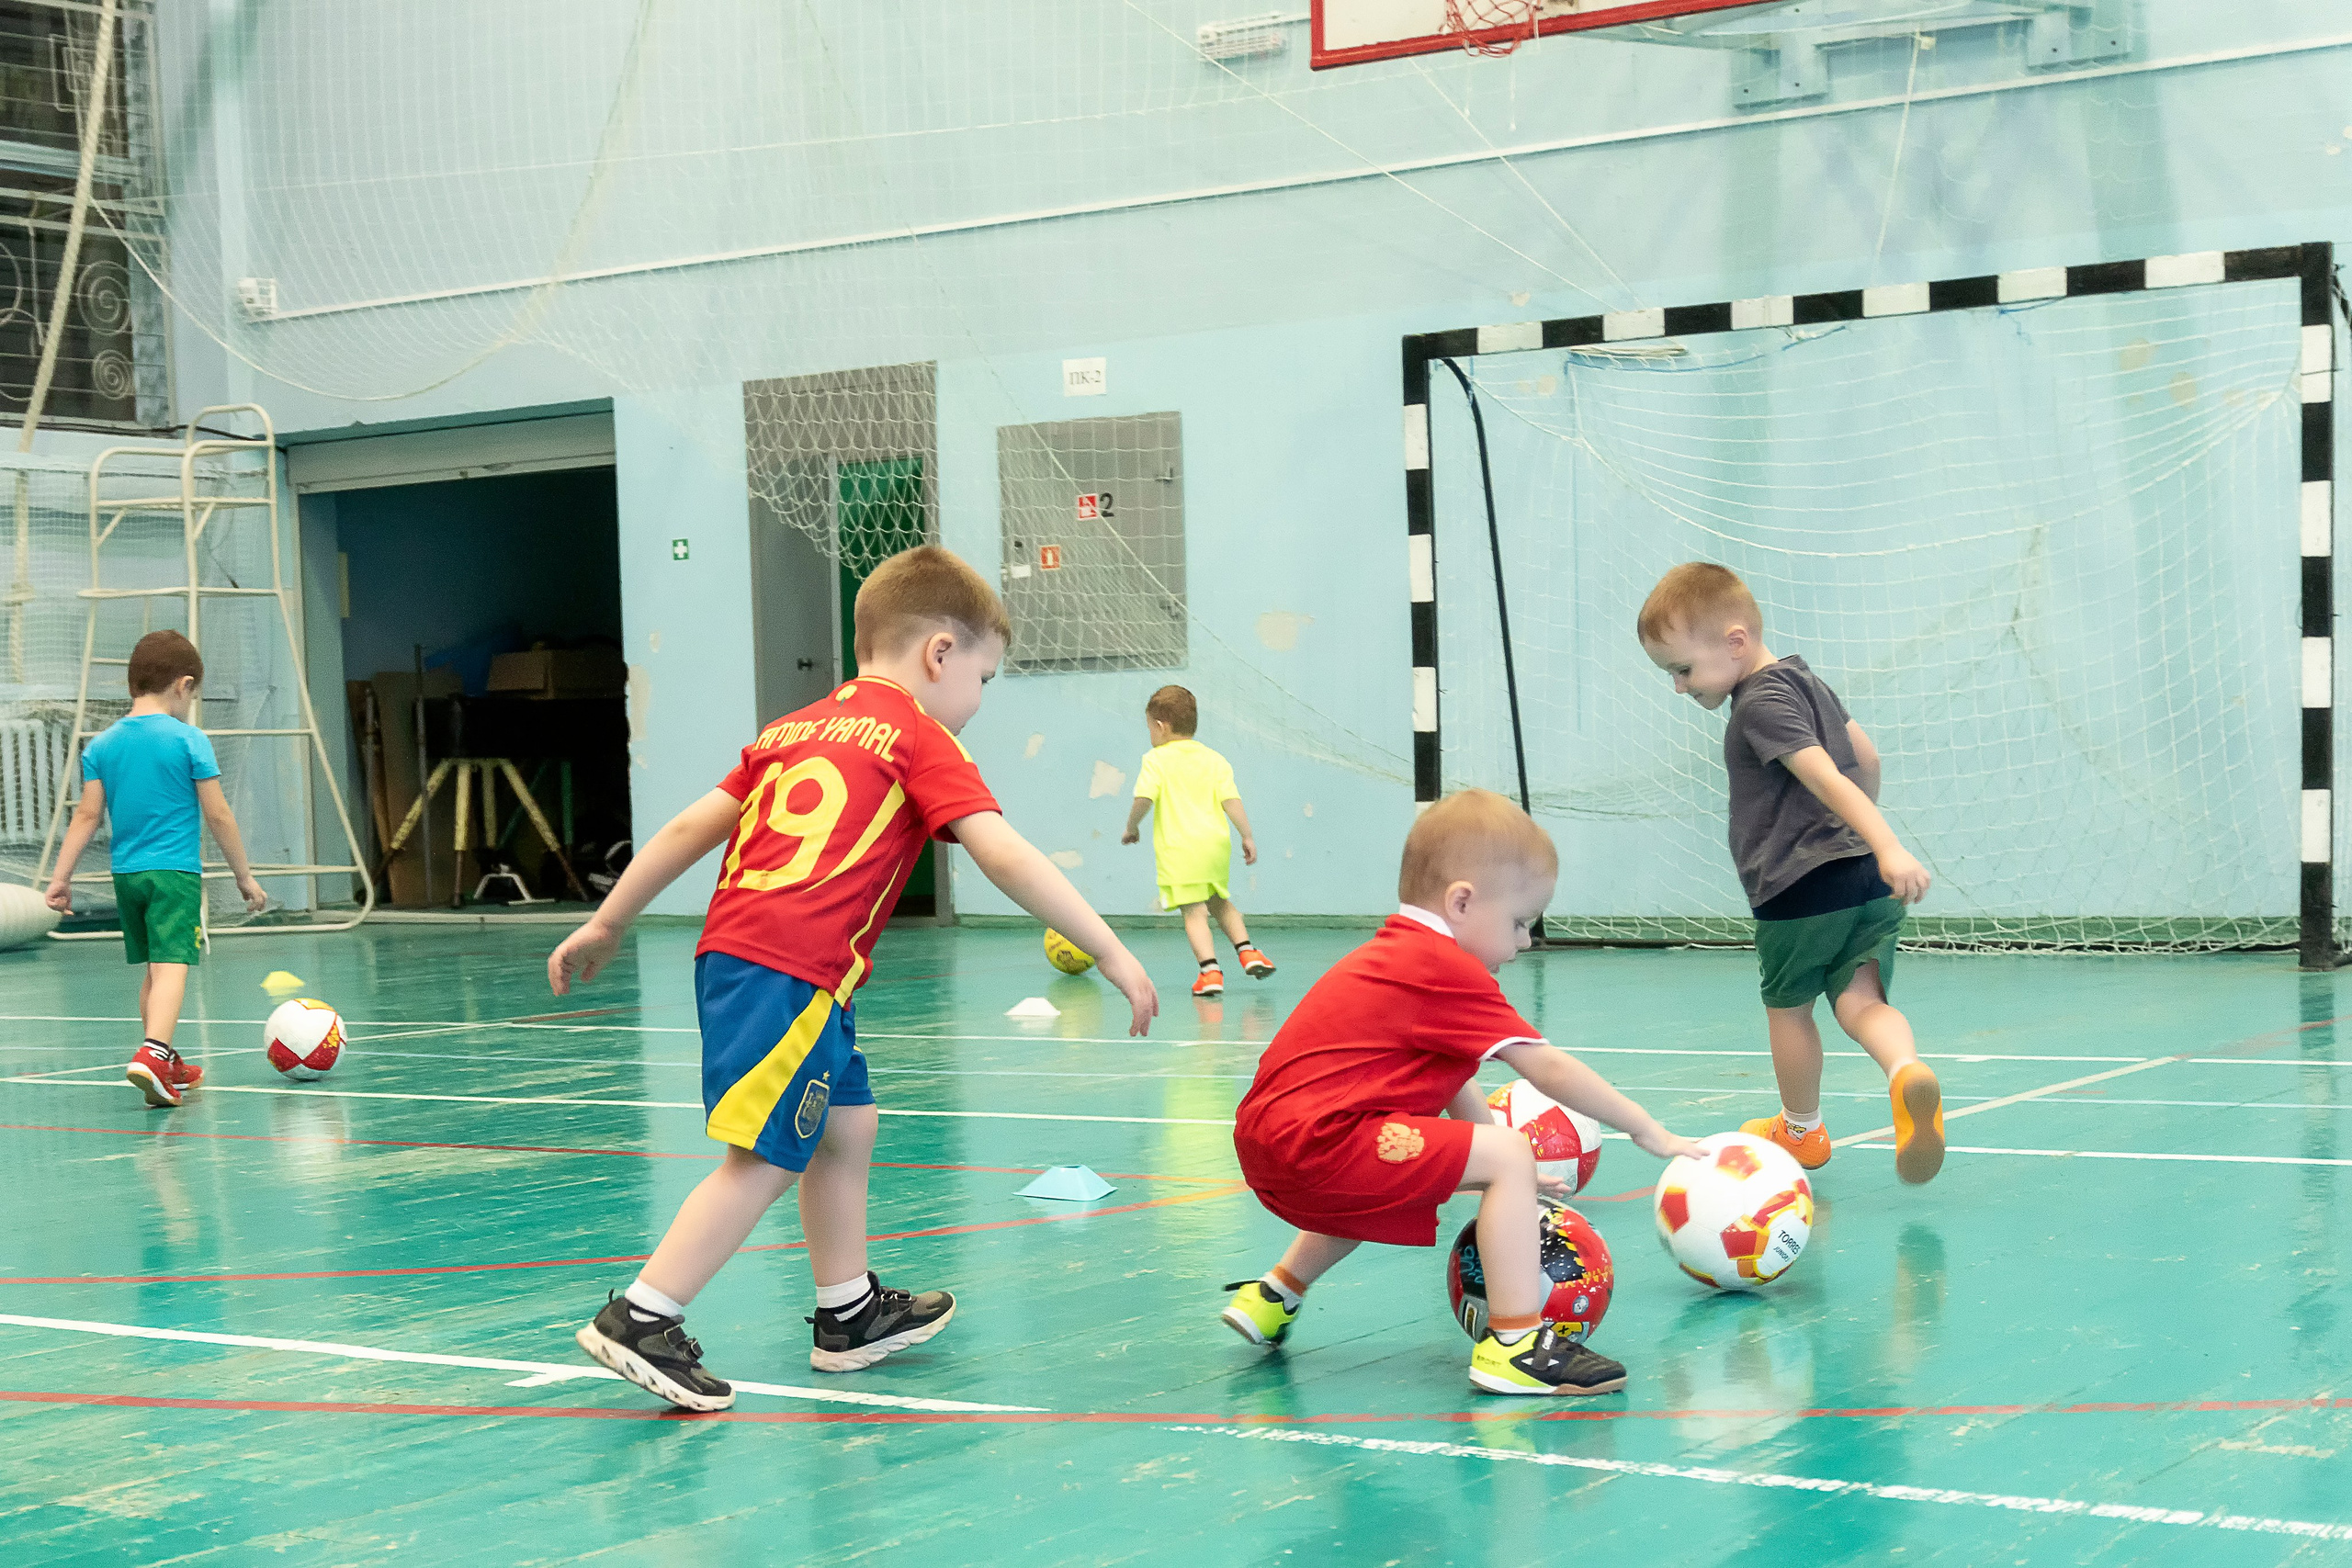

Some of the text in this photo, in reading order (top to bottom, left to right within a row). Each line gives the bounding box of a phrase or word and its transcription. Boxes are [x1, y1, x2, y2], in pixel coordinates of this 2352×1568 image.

[1069, 370, 1102, 385] ПК-2
[1099, 492, 1114, 517] 2
[752, 716, 901, 763] AMINE YAMAL
[718, 756, 849, 891] 19
[1778, 1229, 1802, 1255] TORRES
